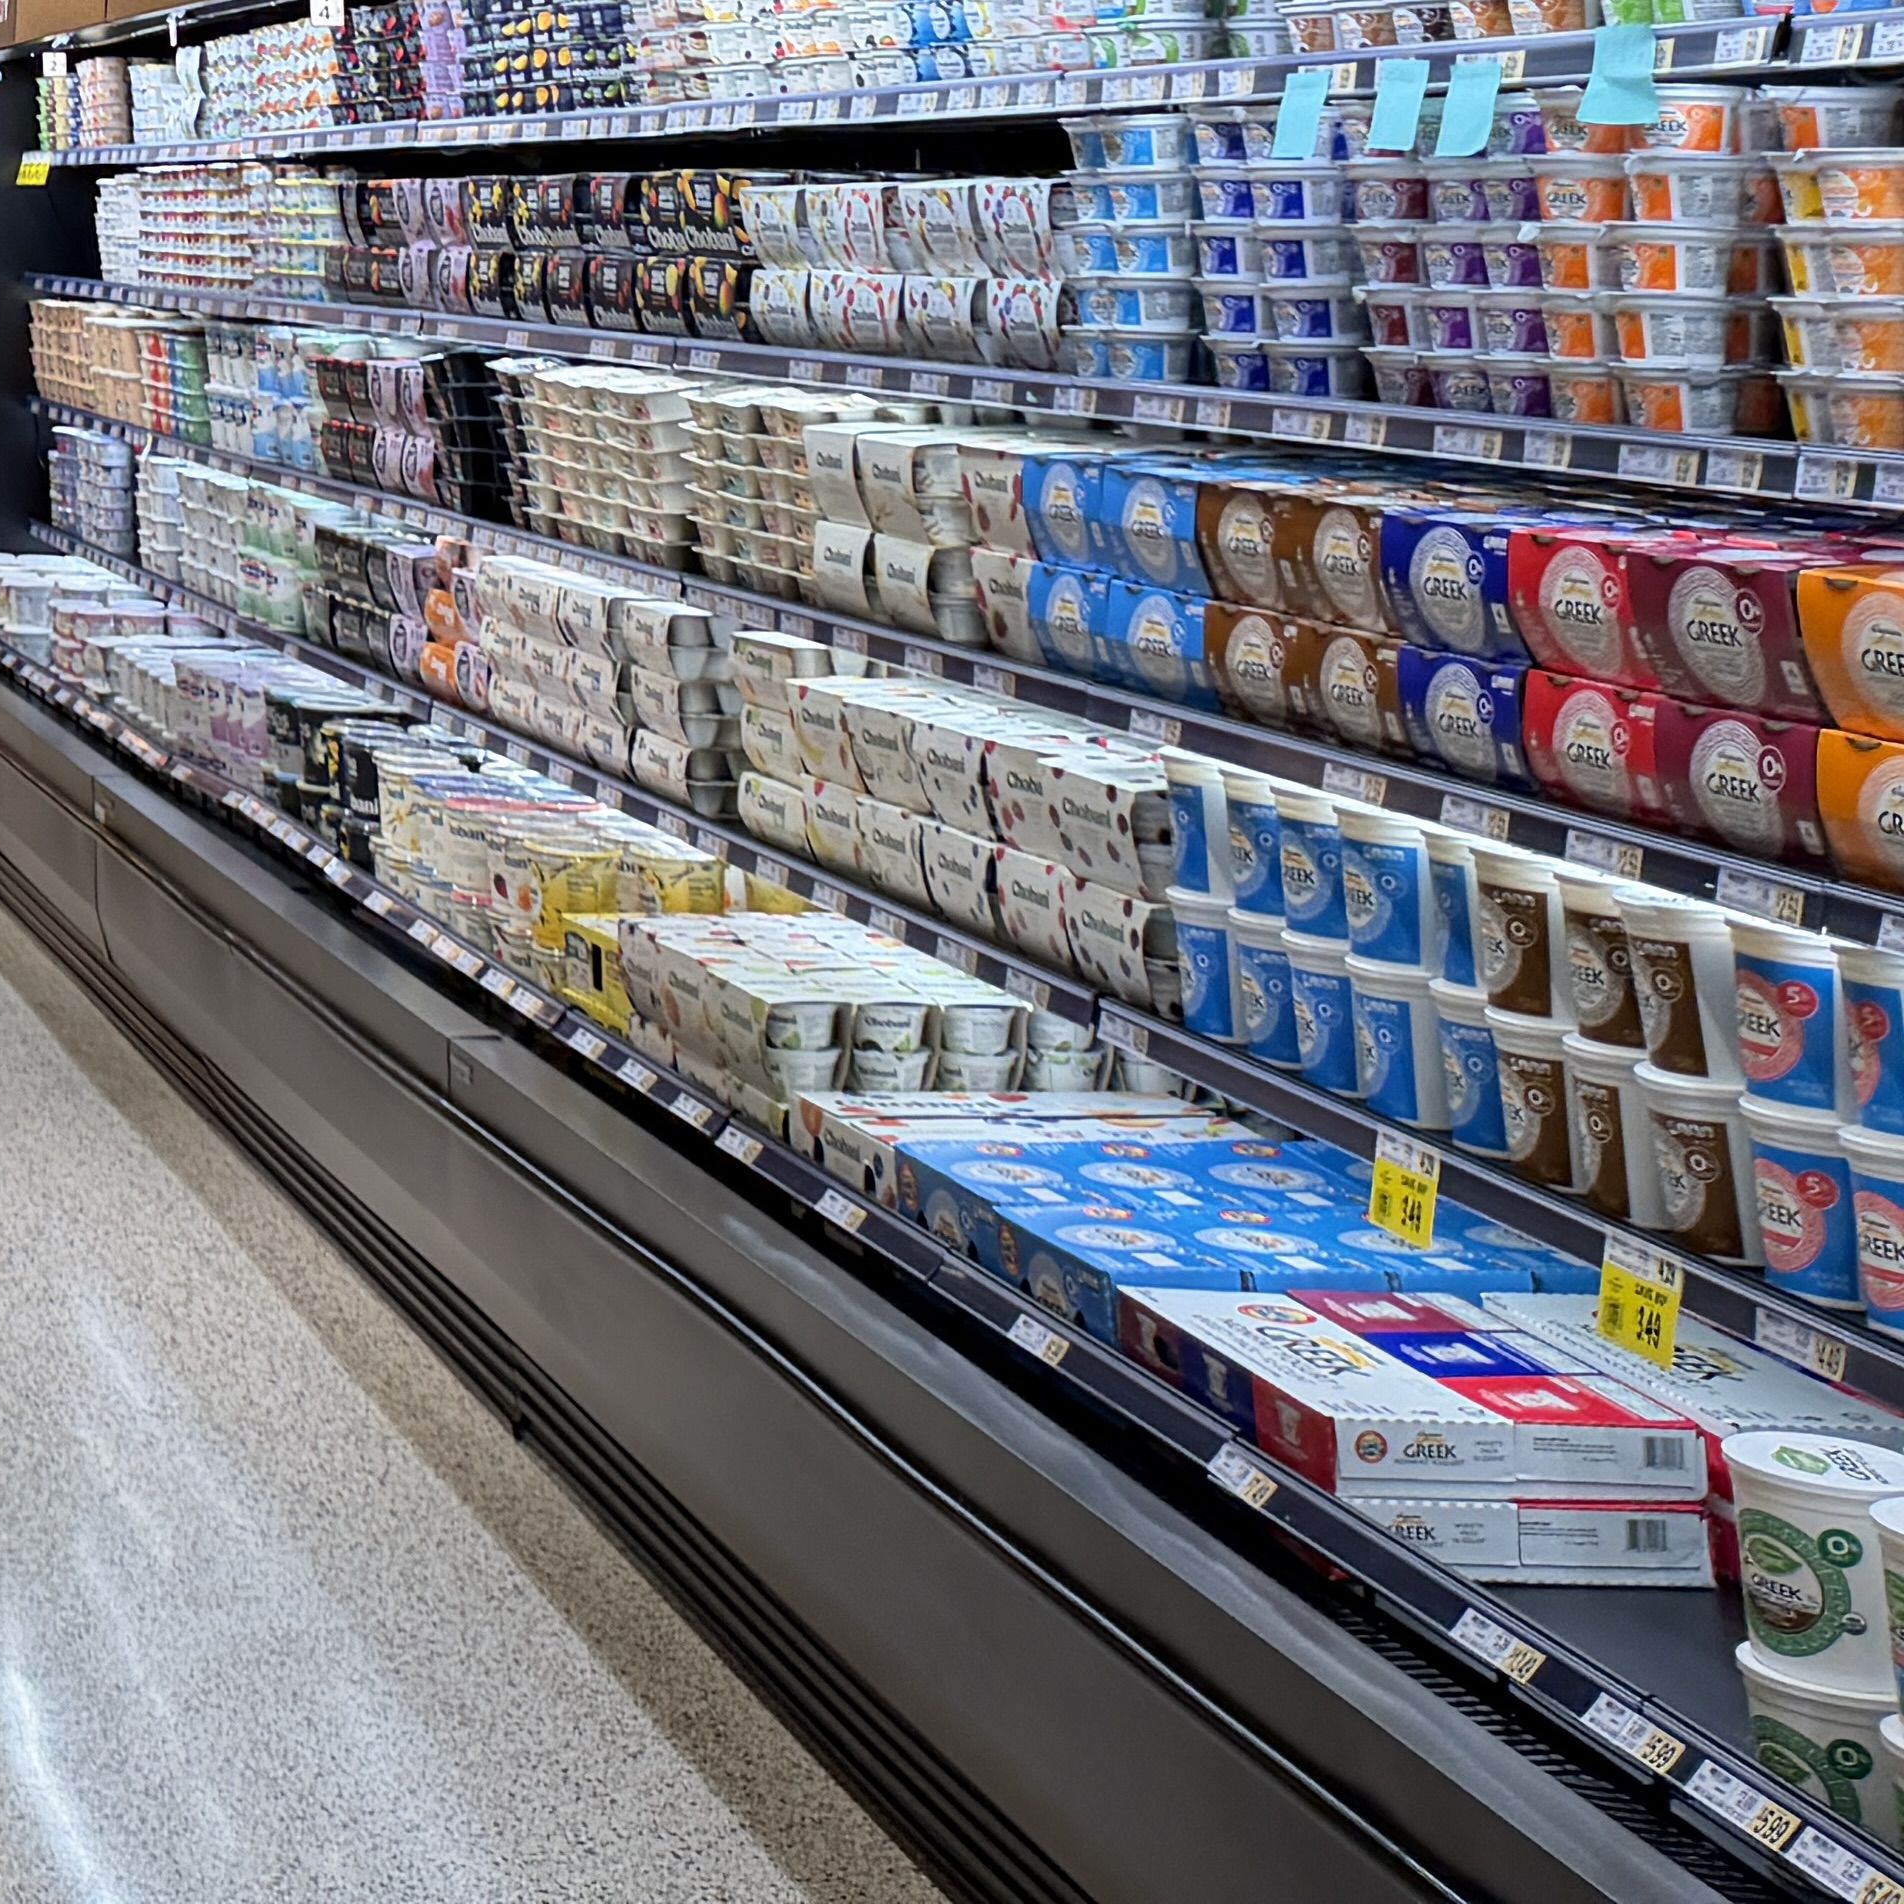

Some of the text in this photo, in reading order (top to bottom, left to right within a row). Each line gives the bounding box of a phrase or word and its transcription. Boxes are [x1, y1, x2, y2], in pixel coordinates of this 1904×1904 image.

[319, 4, 331, 20] 4
[1424, 575, 1468, 600] GREEK
[1555, 598, 1603, 625] GREEK
[1686, 620, 1742, 648] GREEK
[1331, 681, 1365, 706] GREEK
[1567, 742, 1612, 770] GREEK
[1706, 773, 1760, 802] GREEK
[1403, 1444, 1457, 1458] GREEK
[1751, 1573, 1803, 1601] GREEK
